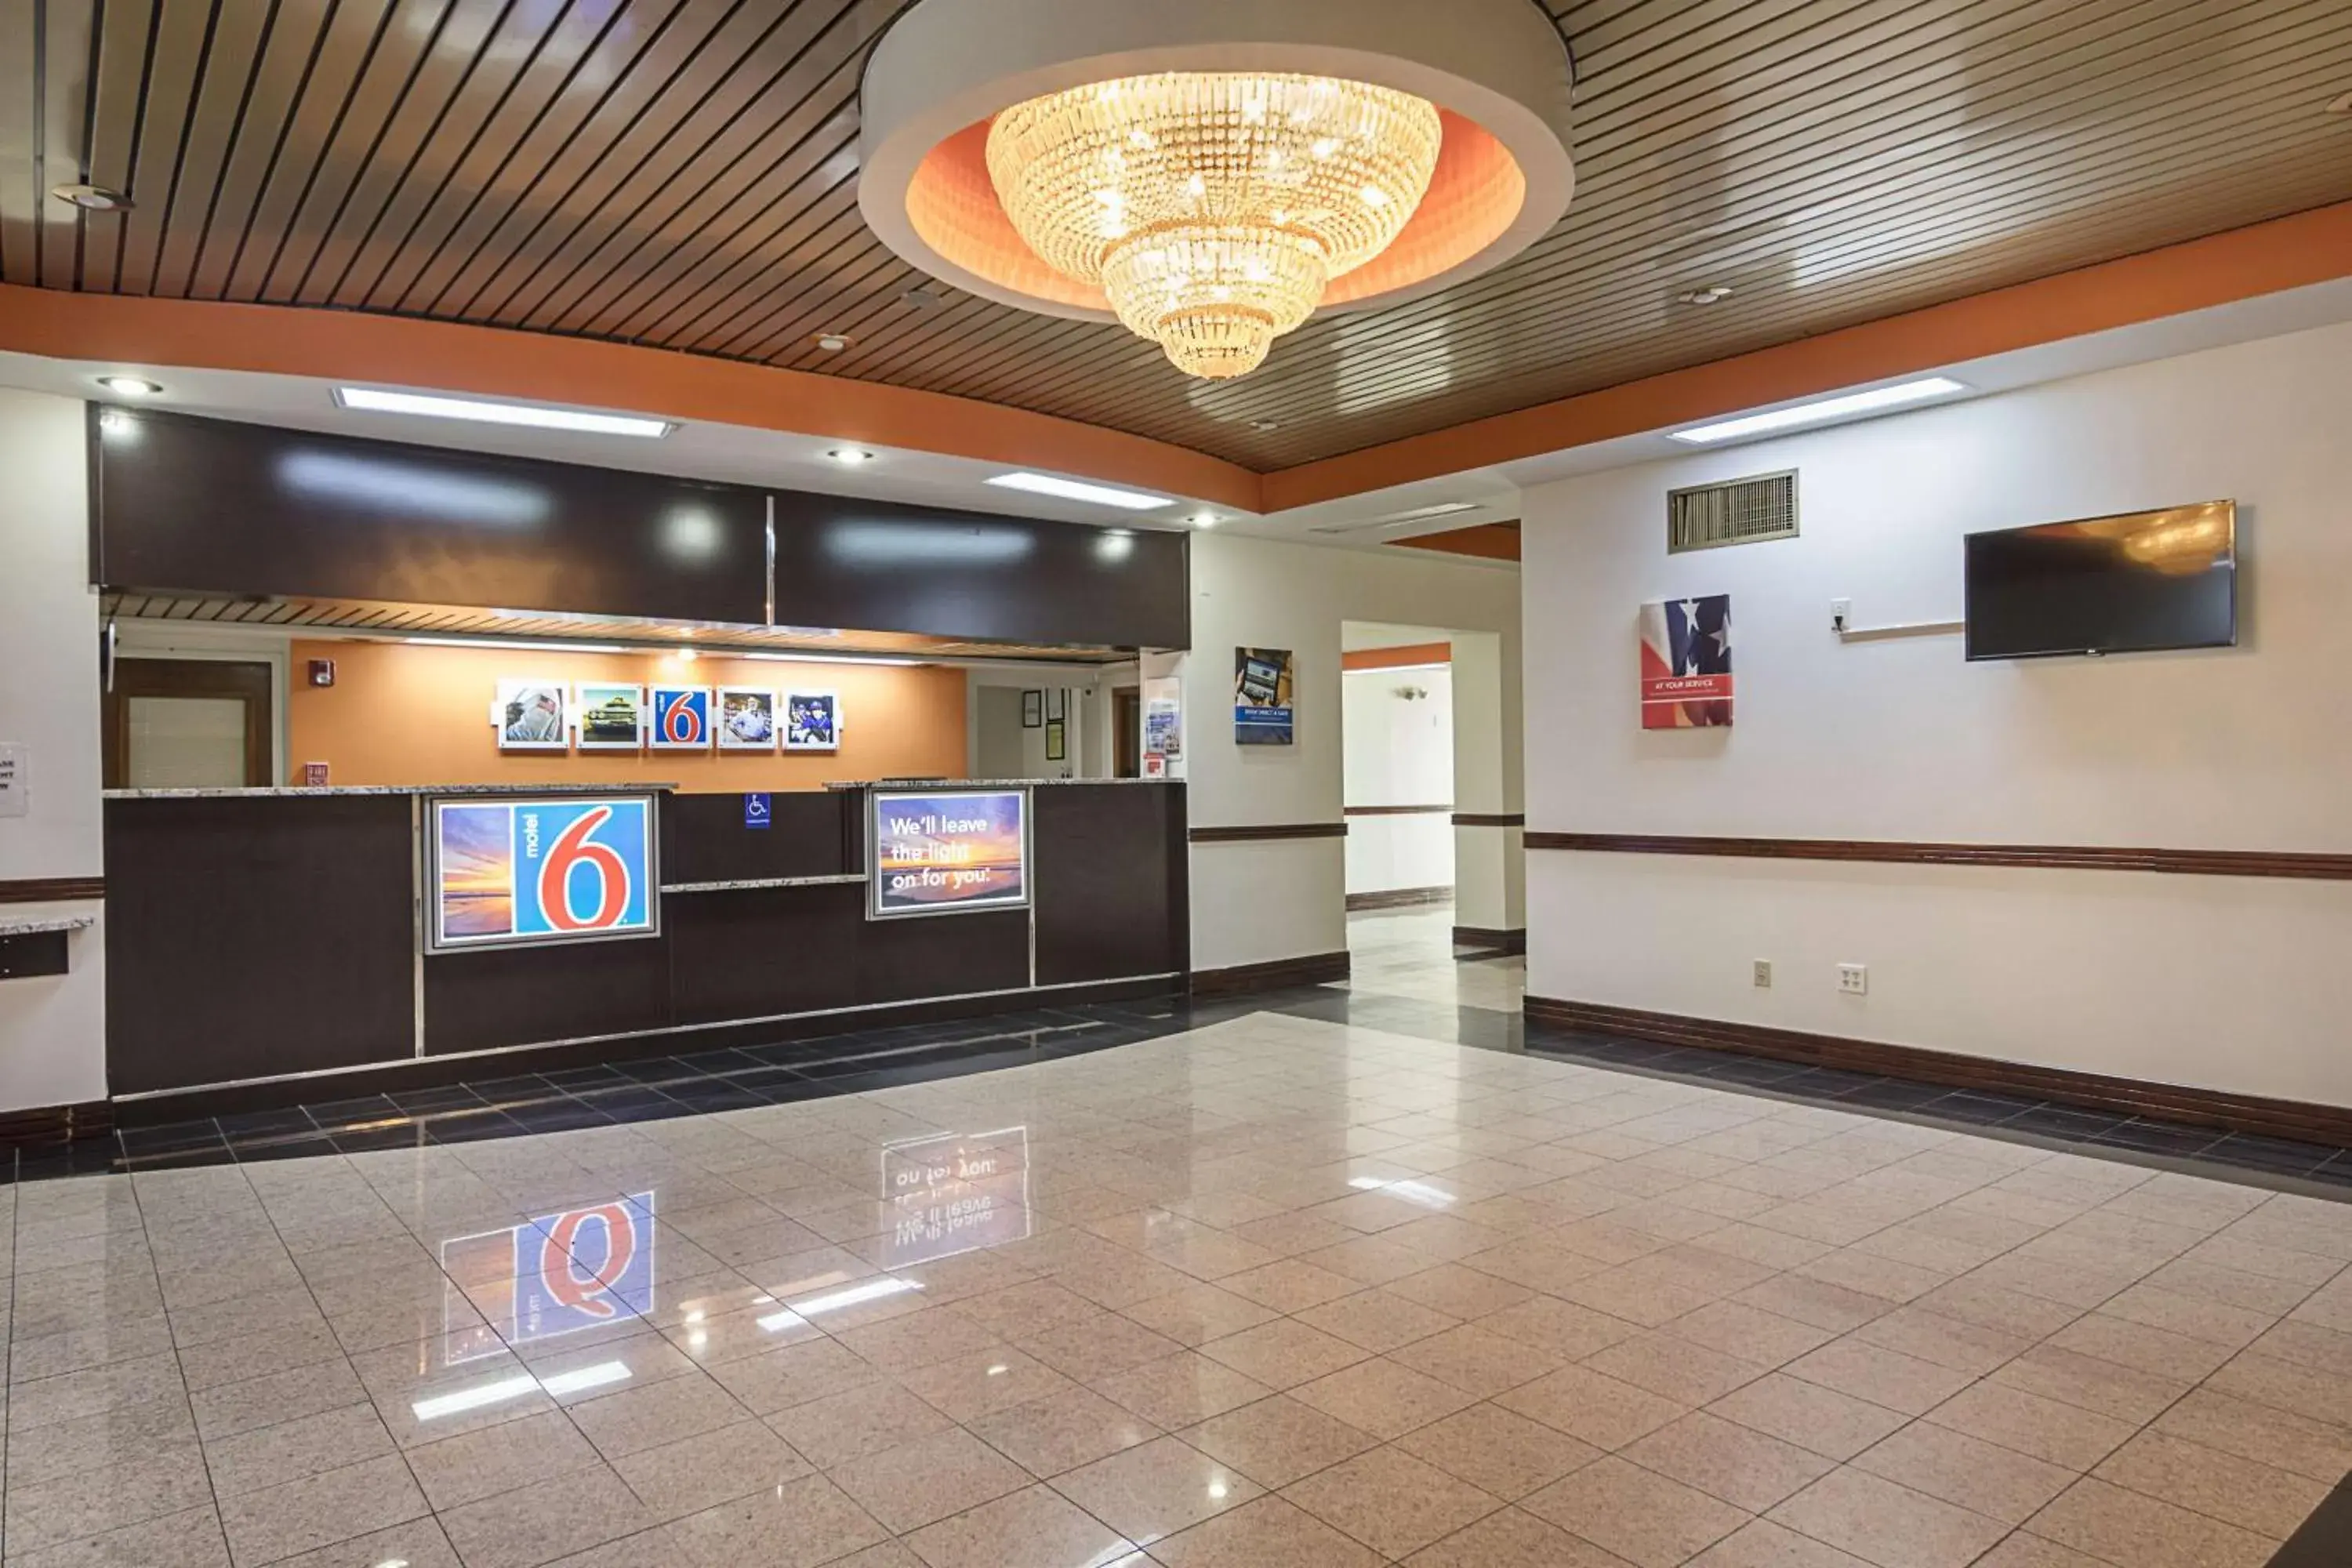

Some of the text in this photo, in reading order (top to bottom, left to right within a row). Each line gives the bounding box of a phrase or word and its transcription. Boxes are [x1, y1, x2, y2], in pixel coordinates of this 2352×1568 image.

[663, 691, 701, 743] 6
[891, 815, 988, 835] We'll leave
[891, 841, 969, 864] the light
[522, 806, 631, 931] motel 6
[891, 873, 916, 889] on
[921, 868, 947, 886] for
